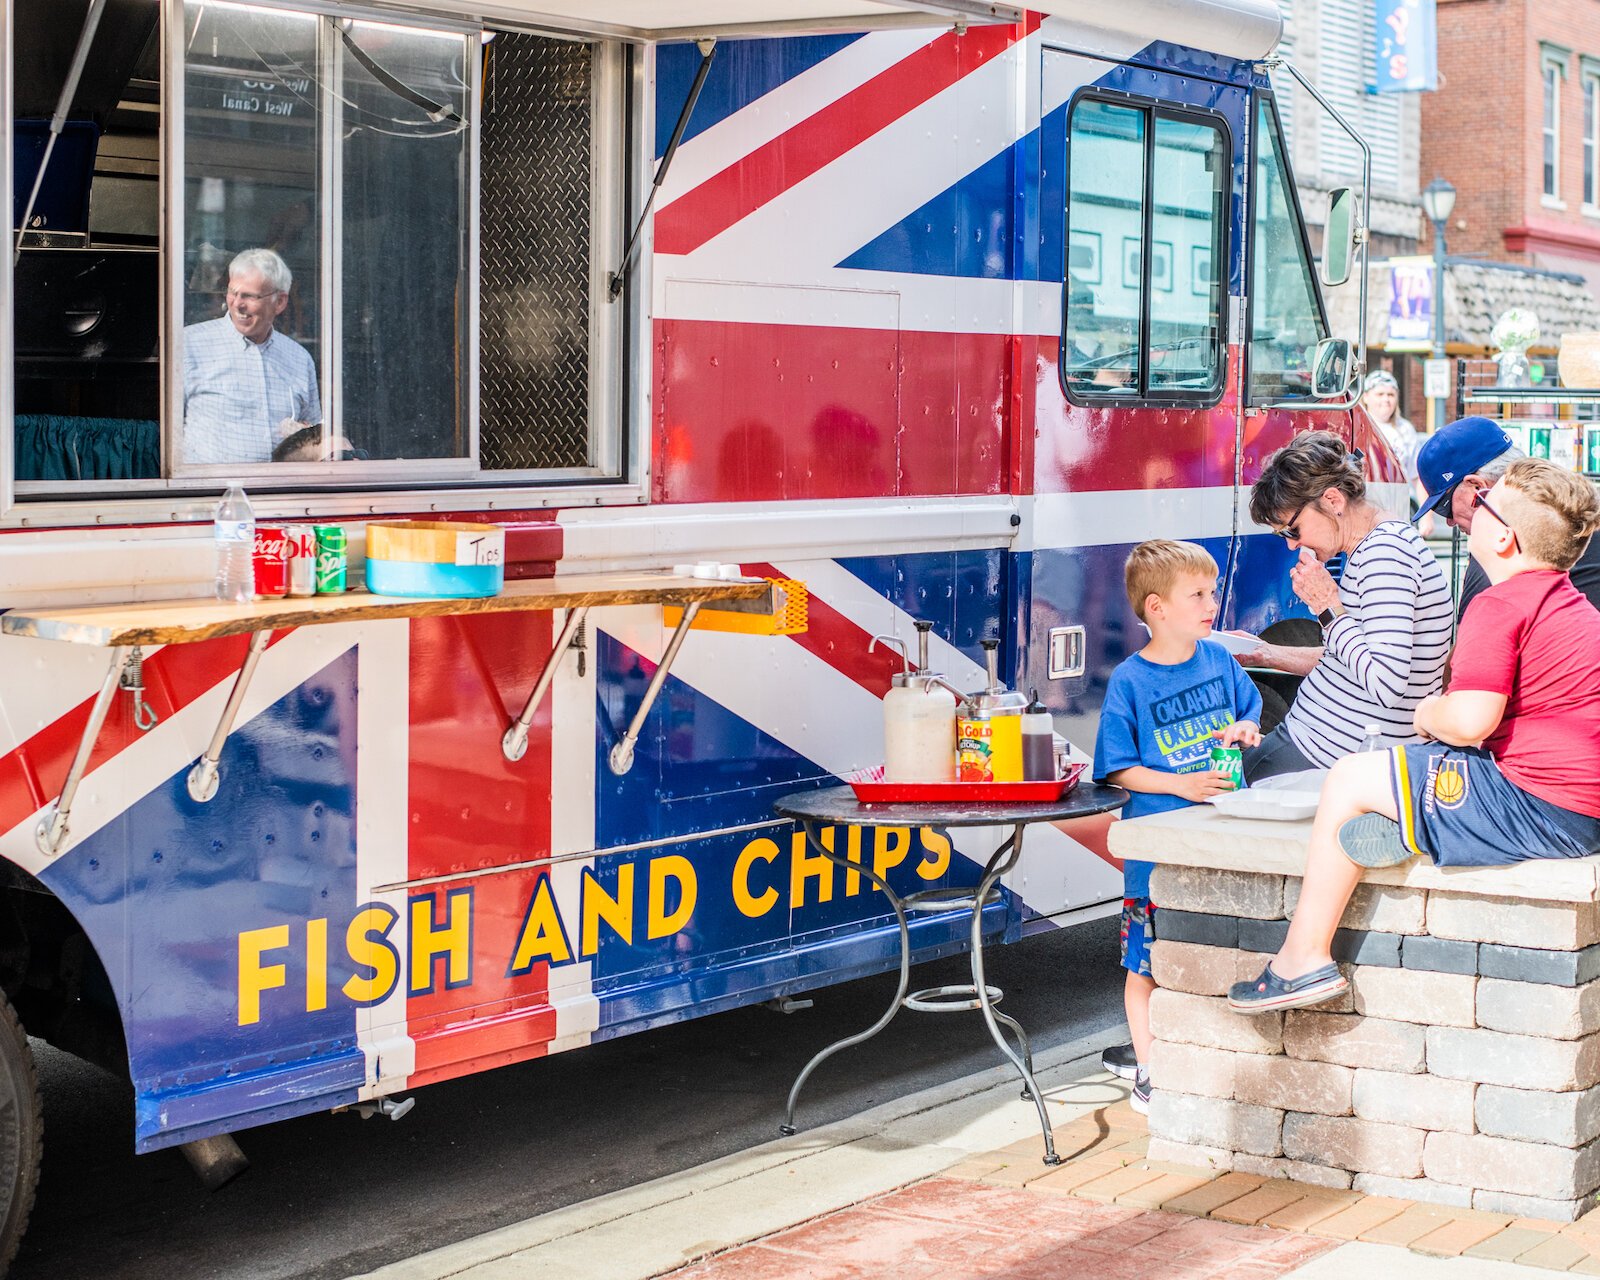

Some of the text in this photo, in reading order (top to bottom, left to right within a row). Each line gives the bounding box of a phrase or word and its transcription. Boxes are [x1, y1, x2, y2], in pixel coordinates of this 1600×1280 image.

[469, 537, 499, 566] Tips
[1156, 681, 1227, 724] OKLAHOMA
[965, 725, 993, 737] GOLD
[1177, 761, 1207, 774] UNITED
[237, 826, 951, 1026] FISH AND CHIPS
